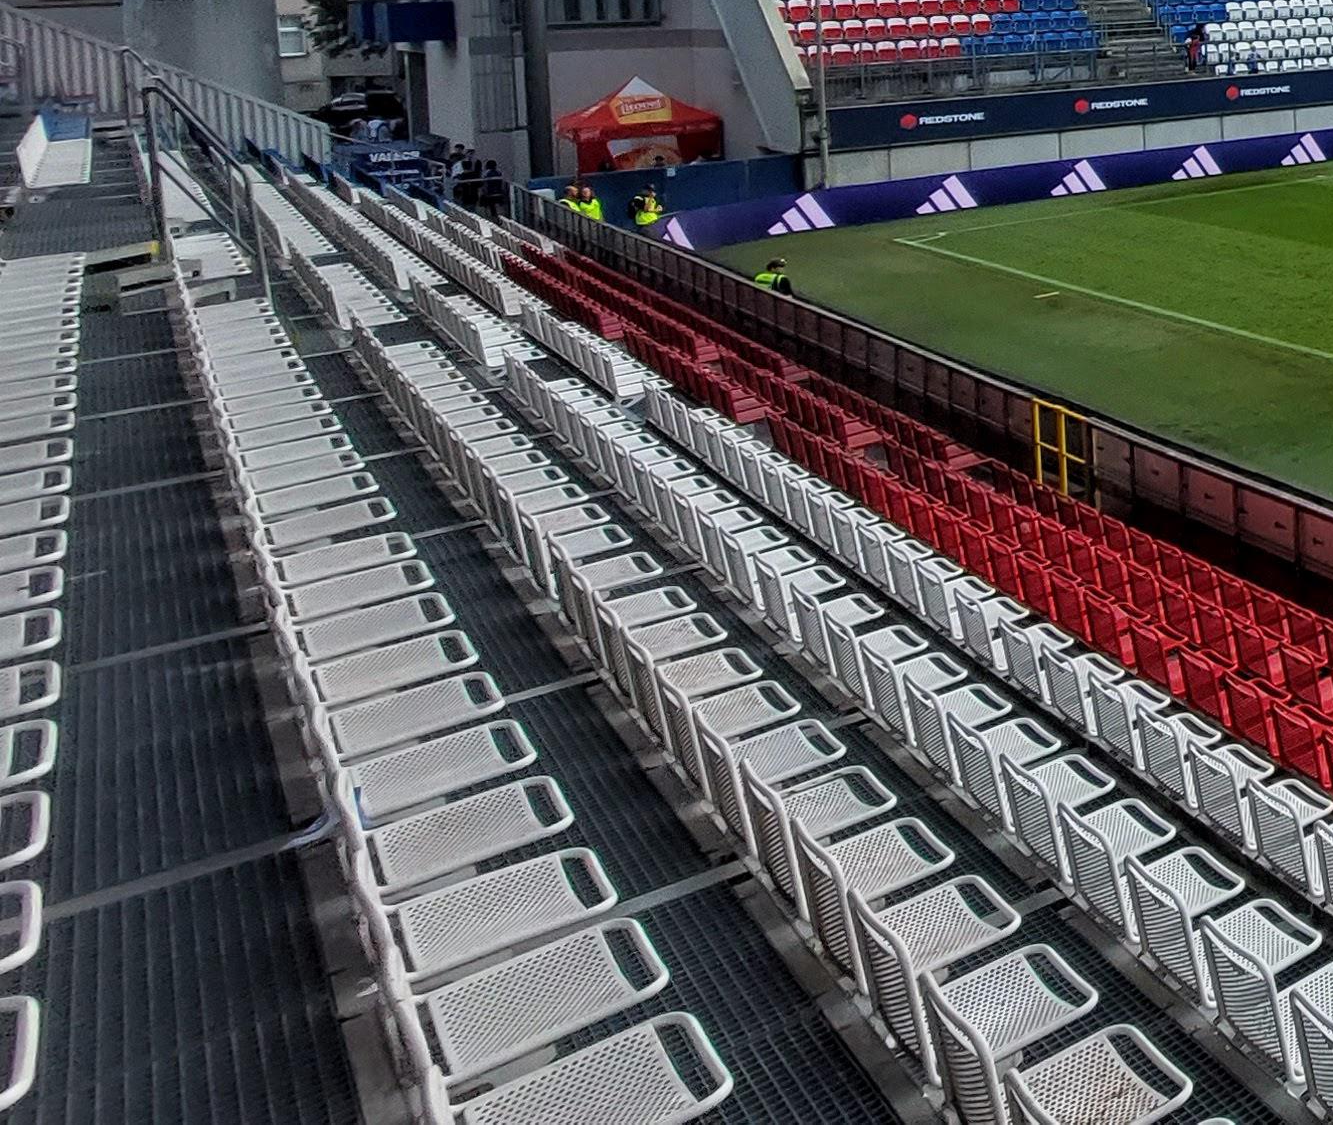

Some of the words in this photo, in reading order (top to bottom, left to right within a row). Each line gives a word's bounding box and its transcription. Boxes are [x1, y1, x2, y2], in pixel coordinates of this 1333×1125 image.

[1240, 85, 1290, 97] REDSTONE
[1091, 98, 1148, 110] REDSTONE
[918, 112, 985, 125] REDSTONE
